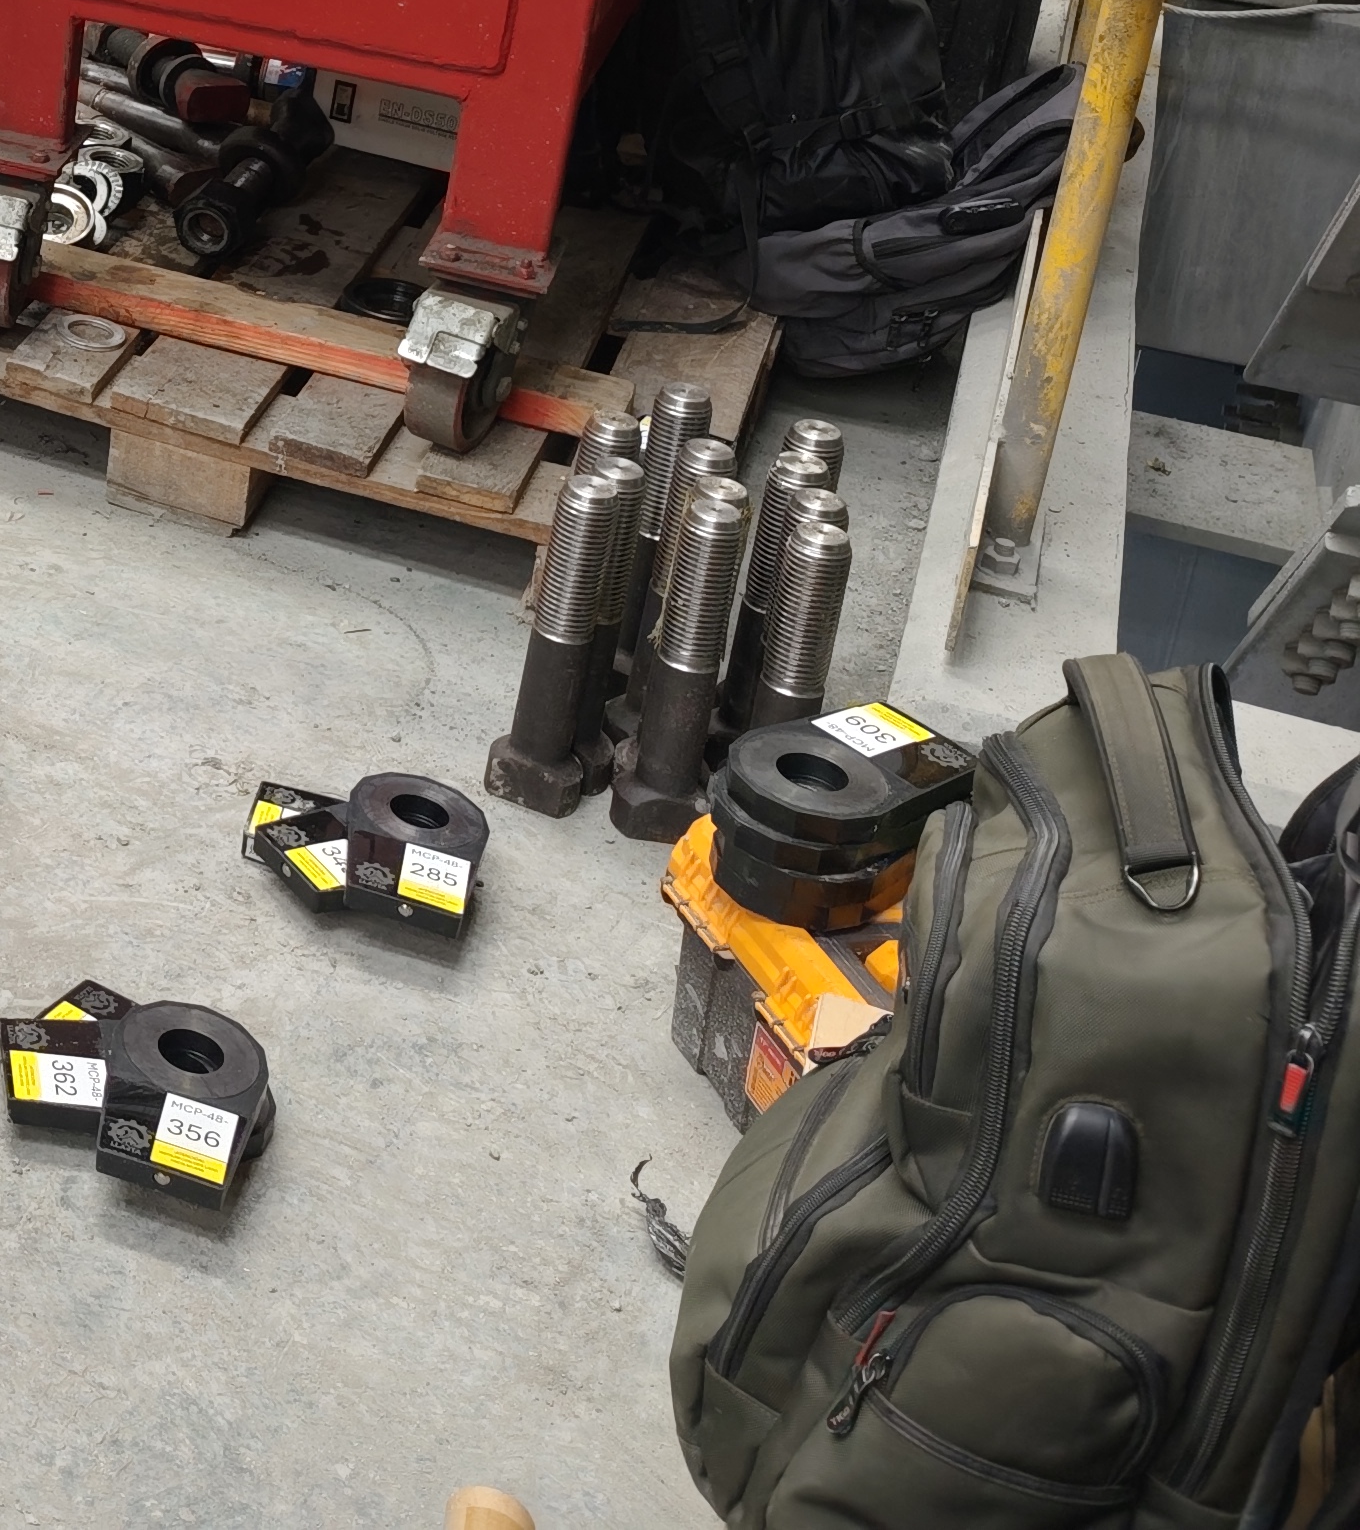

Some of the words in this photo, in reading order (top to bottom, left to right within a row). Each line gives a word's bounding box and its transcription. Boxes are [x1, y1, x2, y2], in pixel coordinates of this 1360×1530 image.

[845, 715, 897, 744] 309
[409, 862, 458, 887] 285
[51, 1059, 78, 1097] 362
[166, 1118, 222, 1148] 356
